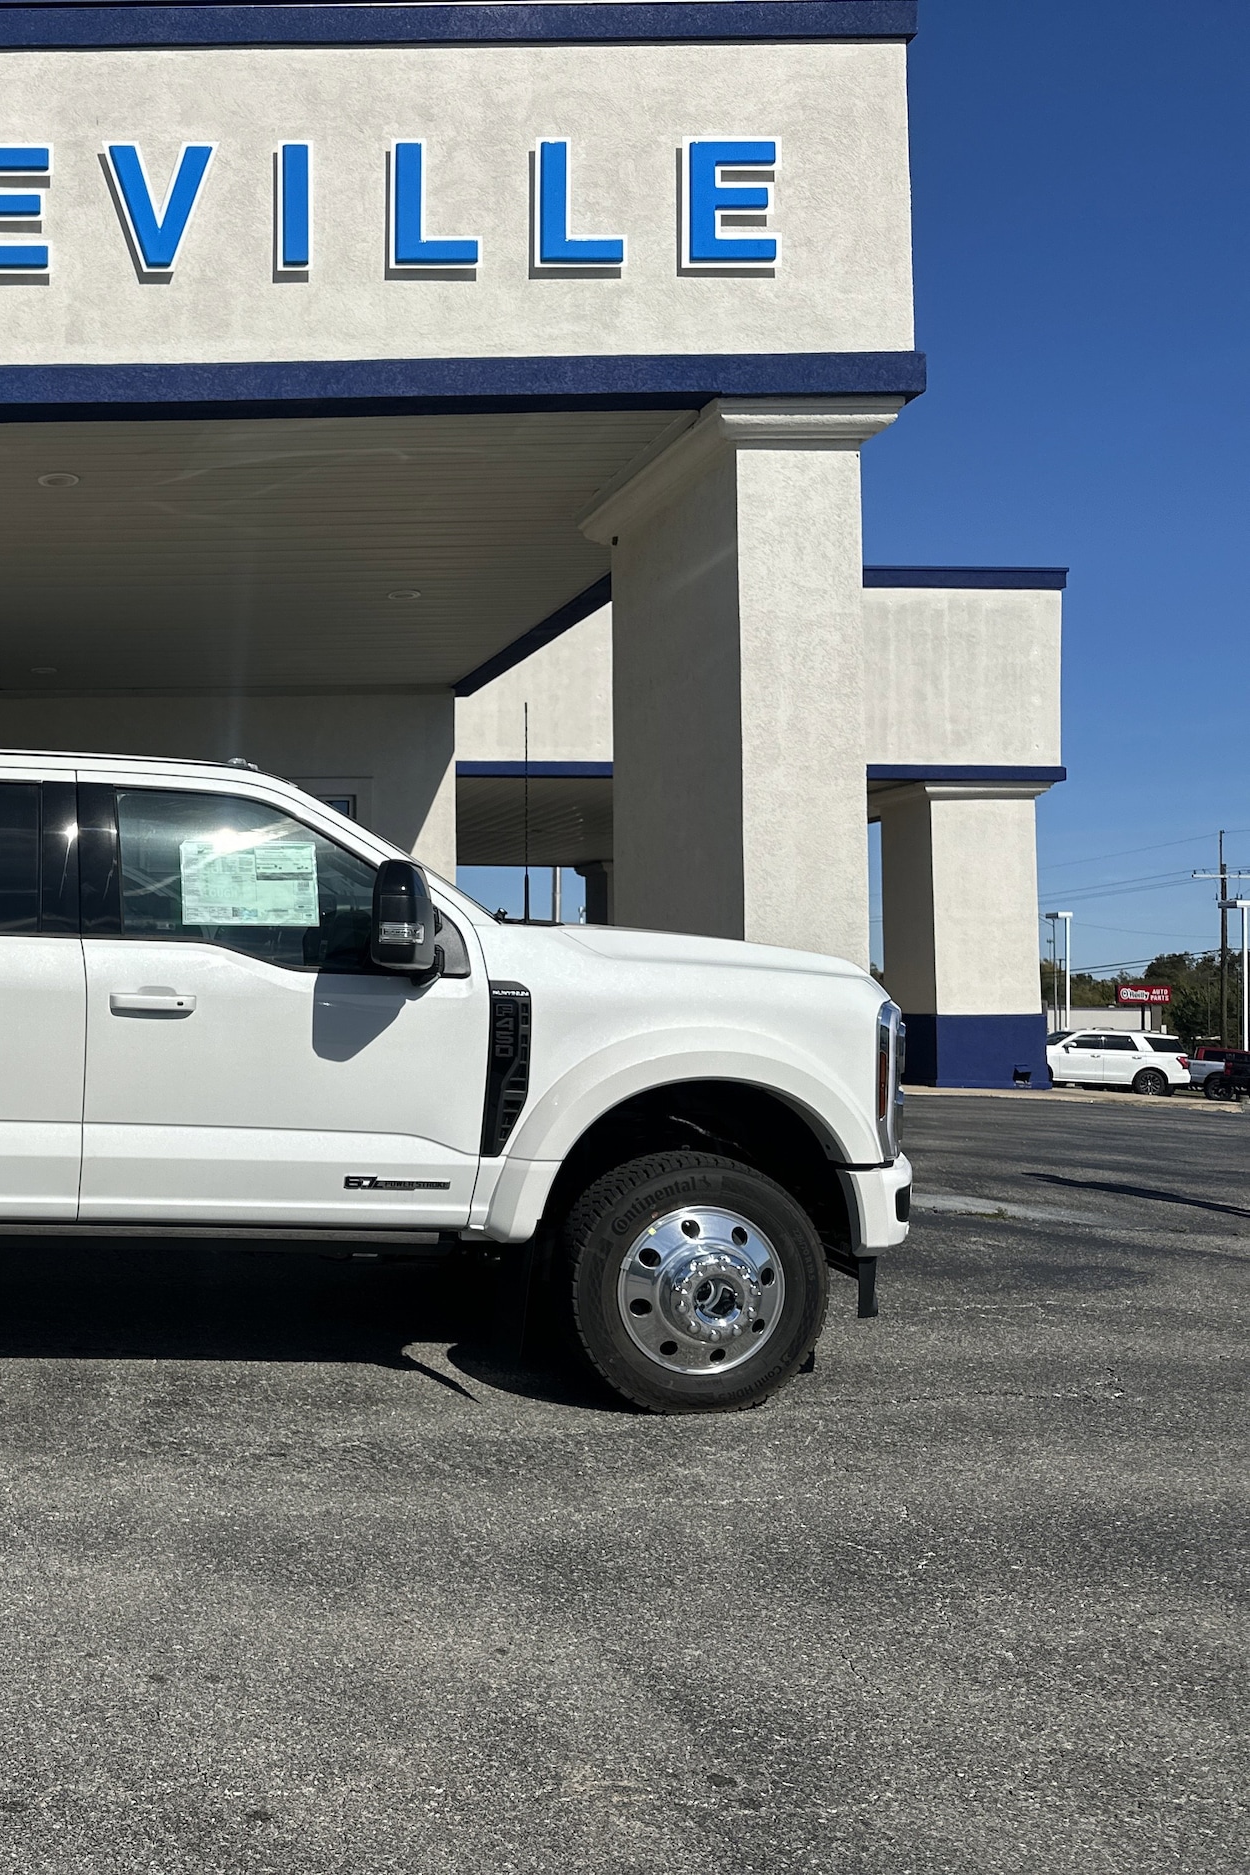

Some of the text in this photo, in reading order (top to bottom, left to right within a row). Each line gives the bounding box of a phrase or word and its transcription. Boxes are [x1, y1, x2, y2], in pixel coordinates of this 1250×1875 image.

[1120, 988, 1150, 1001] O'Reilly
[611, 1175, 697, 1236] Continental
[753, 1365, 782, 1390] Conti
